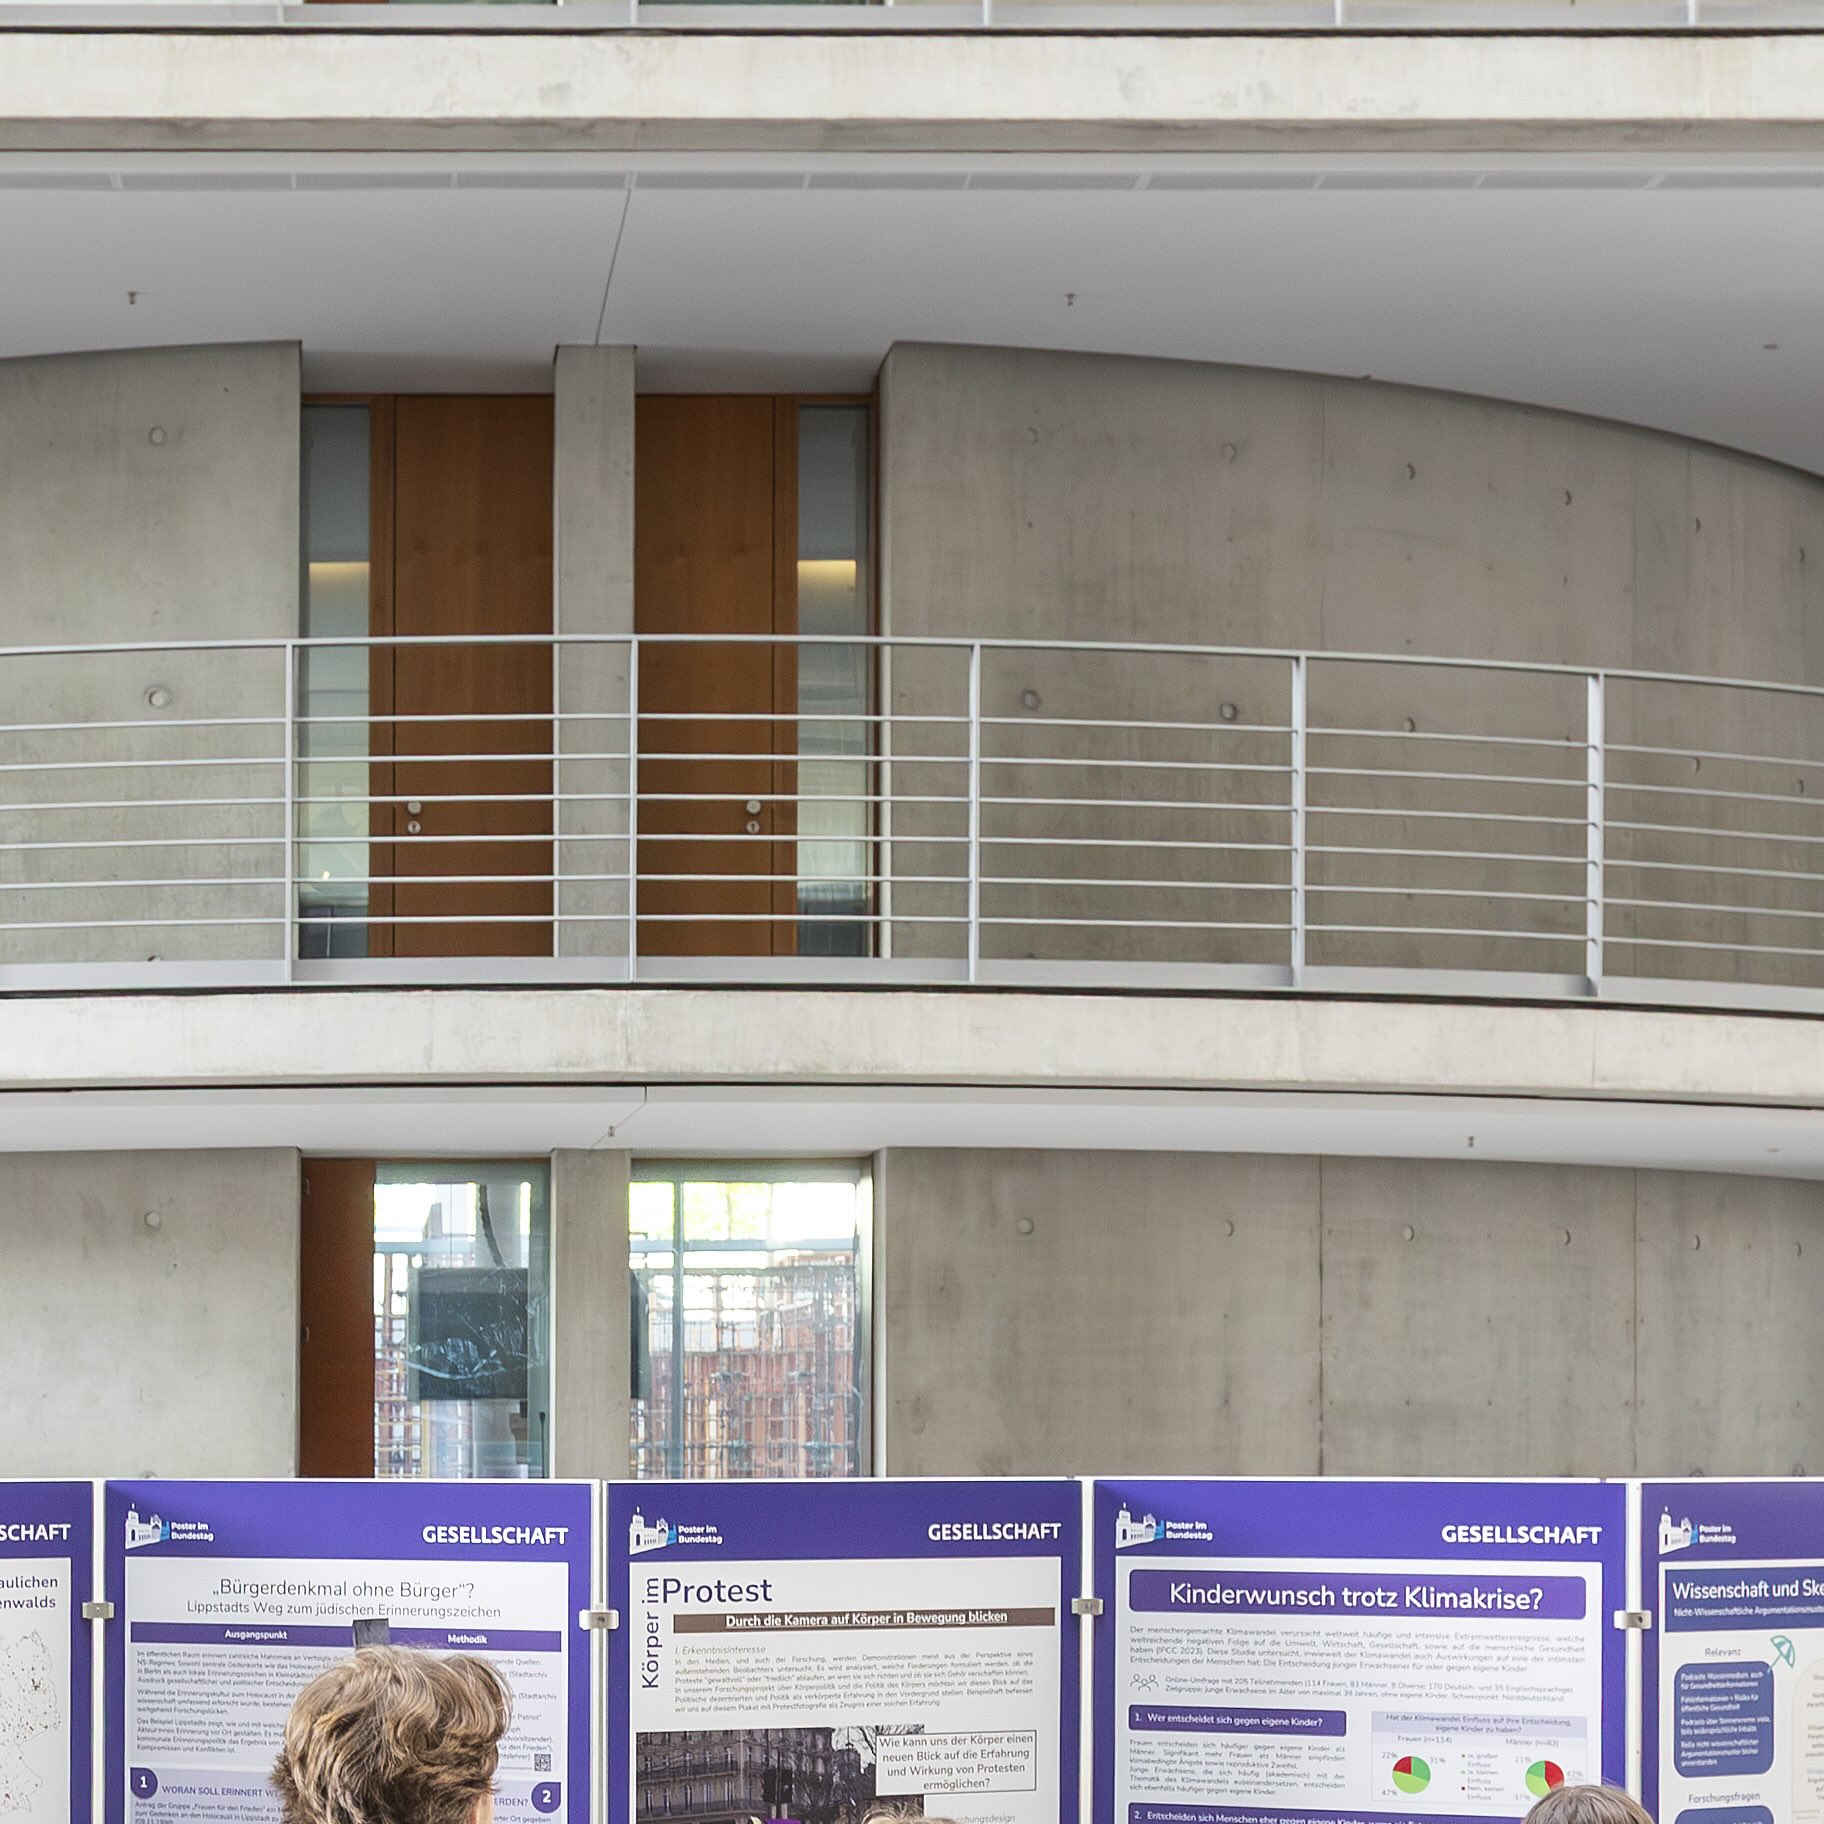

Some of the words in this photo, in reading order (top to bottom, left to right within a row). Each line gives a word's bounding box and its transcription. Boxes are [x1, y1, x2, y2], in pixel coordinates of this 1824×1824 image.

[422, 1525, 569, 1545] GESELLSCHAFT
[678, 1525, 705, 1534] Poster
[705, 1524, 717, 1533] im
[927, 1522, 1061, 1540] GESELLSCHAFT
[1441, 1525, 1602, 1544] GESELLSCHAFT
[678, 1534, 723, 1544] Bundestag
[352, 1581, 394, 1597] ohne
[642, 1578, 659, 1604] im
[663, 1578, 772, 1603] Protest
[1170, 1582, 1335, 1606] Kinderwunsch
[1341, 1587, 1398, 1607] trotz
[1405, 1585, 1543, 1610] Klimakrise?
[1672, 1580, 1769, 1600] Wissenschaft
[1772, 1579, 1799, 1597] und
[187, 1599, 250, 1615] Lippstadts
[253, 1601, 283, 1616] Weg
[286, 1605, 312, 1614] zum
[314, 1602, 374, 1617] jüdischen
[378, 1603, 500, 1619] Erinnerungszeichen
[726, 1614, 763, 1628] Durch
[764, 1613, 782, 1627] die
[785, 1613, 828, 1627] Kamera
[831, 1612, 850, 1626] auf
[852, 1612, 891, 1627] Körper
[893, 1611, 904, 1624] in
[907, 1612, 966, 1626] Bewegung
[969, 1610, 1008, 1624] blicken
[224, 1629, 287, 1640] Ausgangspunkt
[447, 1634, 487, 1644] Methodik
[642, 1611, 663, 1689] Körper
[878, 1737, 900, 1747] Wie
[902, 1737, 927, 1747] kann
[930, 1738, 948, 1746] uns
[950, 1735, 967, 1745] der
[970, 1735, 1004, 1746] Körper
[1006, 1735, 1033, 1744] einen
[882, 1754, 914, 1762] neuen
[916, 1751, 941, 1761] Blick
[943, 1750, 960, 1760] auf
[962, 1749, 978, 1759] die
[980, 1748, 1030, 1760] Erfahrung
[887, 1766, 906, 1776] und
[909, 1765, 953, 1777] Wirkung
[955, 1766, 974, 1774] von
[977, 1763, 1025, 1773] Protesten
[923, 1777, 990, 1791] ermöglichen?
